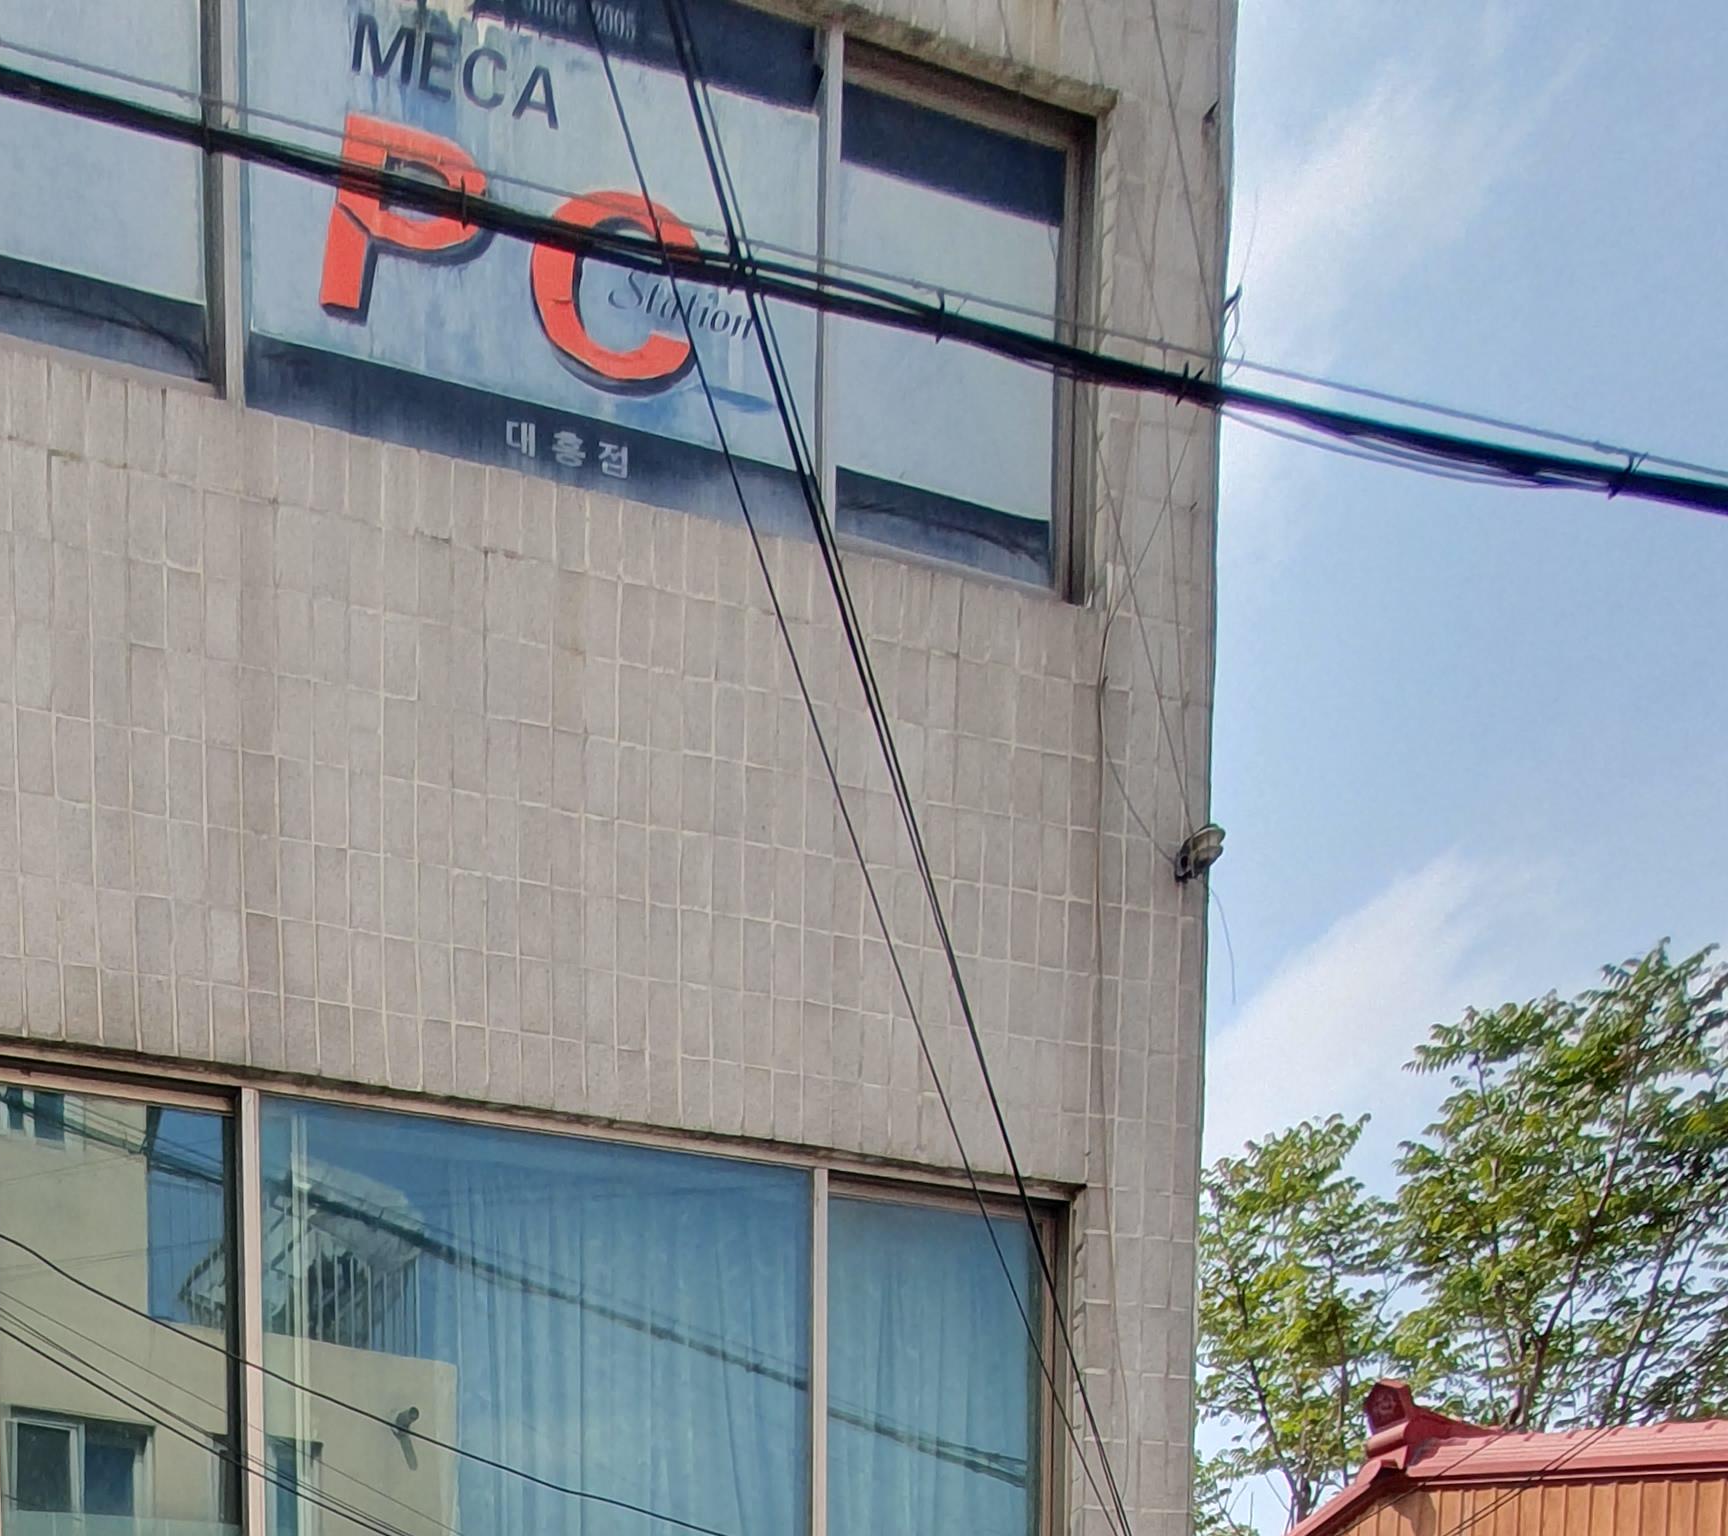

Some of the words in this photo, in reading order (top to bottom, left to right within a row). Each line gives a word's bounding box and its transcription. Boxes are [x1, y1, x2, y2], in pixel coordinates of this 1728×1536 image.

[351, 13, 559, 130] MECA
[607, 274, 756, 342] Station
[505, 419, 630, 480] 대흥점
